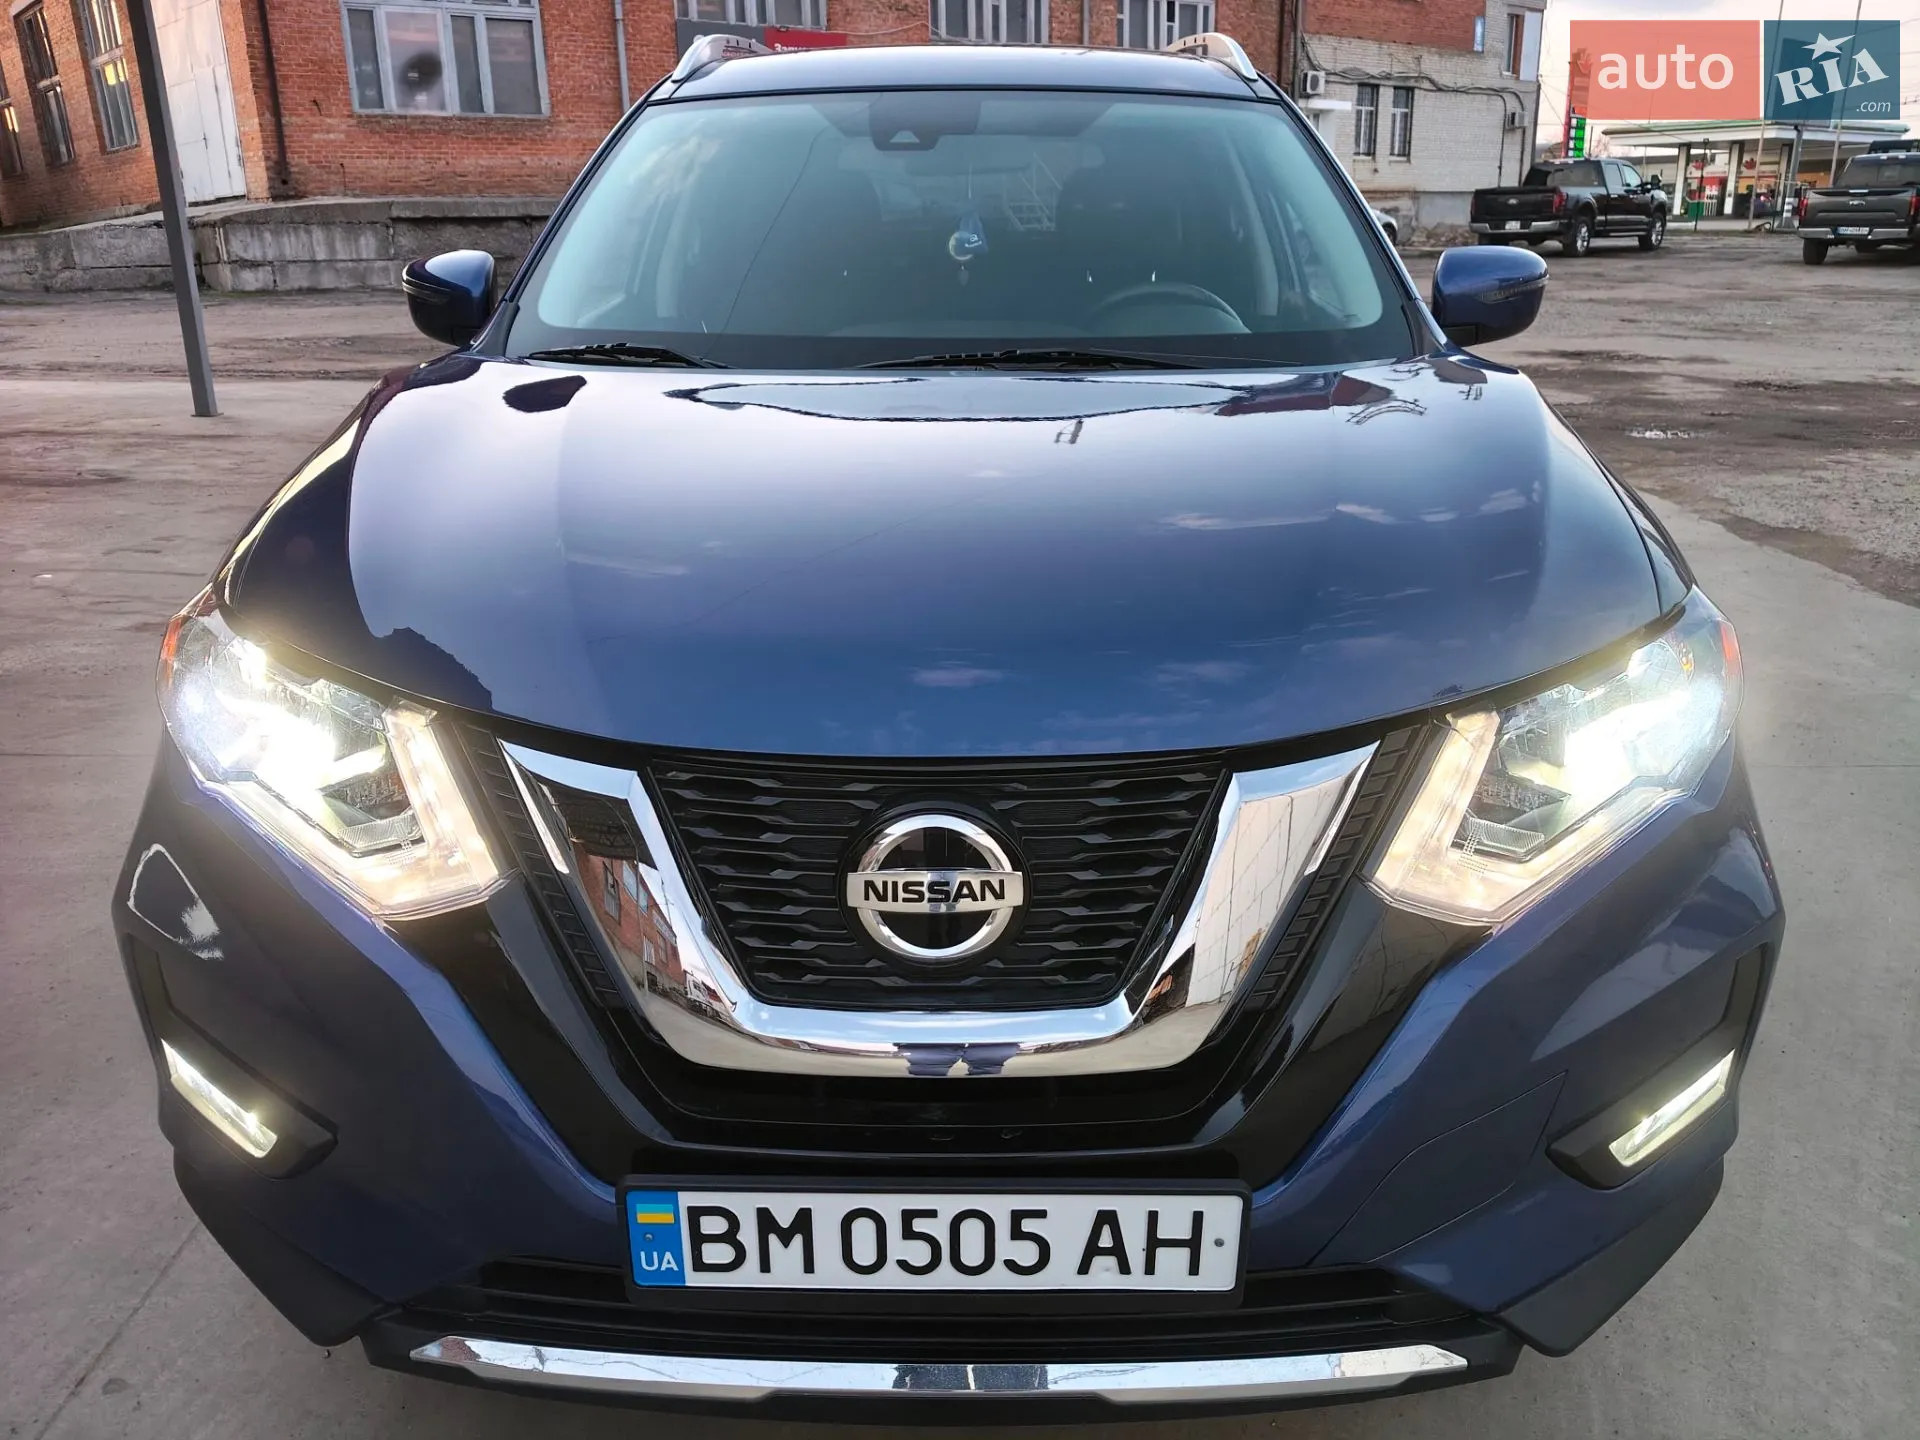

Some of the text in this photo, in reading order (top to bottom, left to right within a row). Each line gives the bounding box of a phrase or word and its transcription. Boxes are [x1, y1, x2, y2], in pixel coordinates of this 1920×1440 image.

[863, 878, 1005, 903] NISSAN
[686, 1205, 1204, 1276] BM 0505 AH
[639, 1251, 679, 1272] UA
